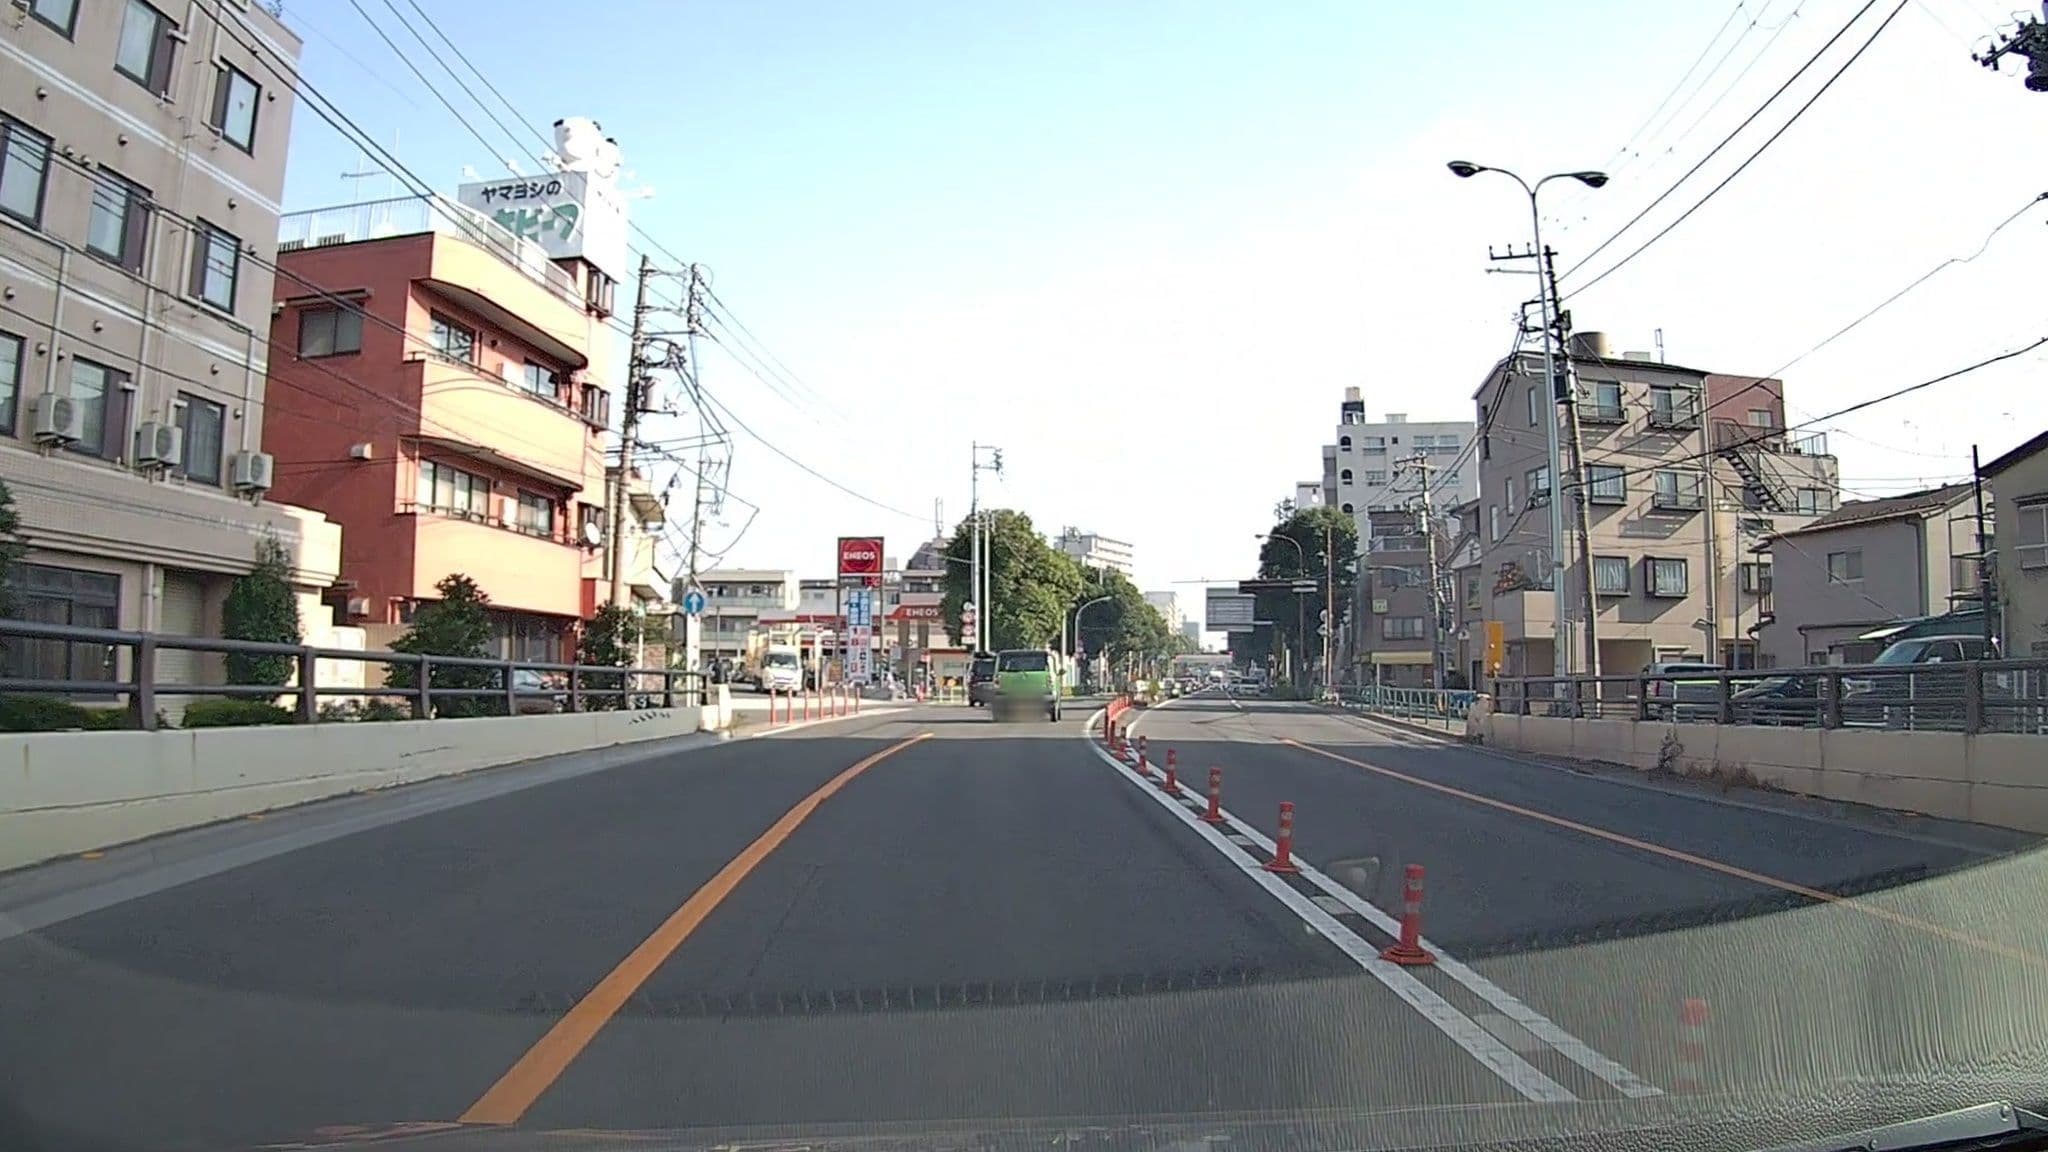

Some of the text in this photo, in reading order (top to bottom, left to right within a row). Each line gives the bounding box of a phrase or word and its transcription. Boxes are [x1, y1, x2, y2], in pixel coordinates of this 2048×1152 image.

[481, 180, 562, 204] ヤマヨシの
[843, 551, 876, 561] ENEOS
[905, 608, 938, 617] ENEOS
